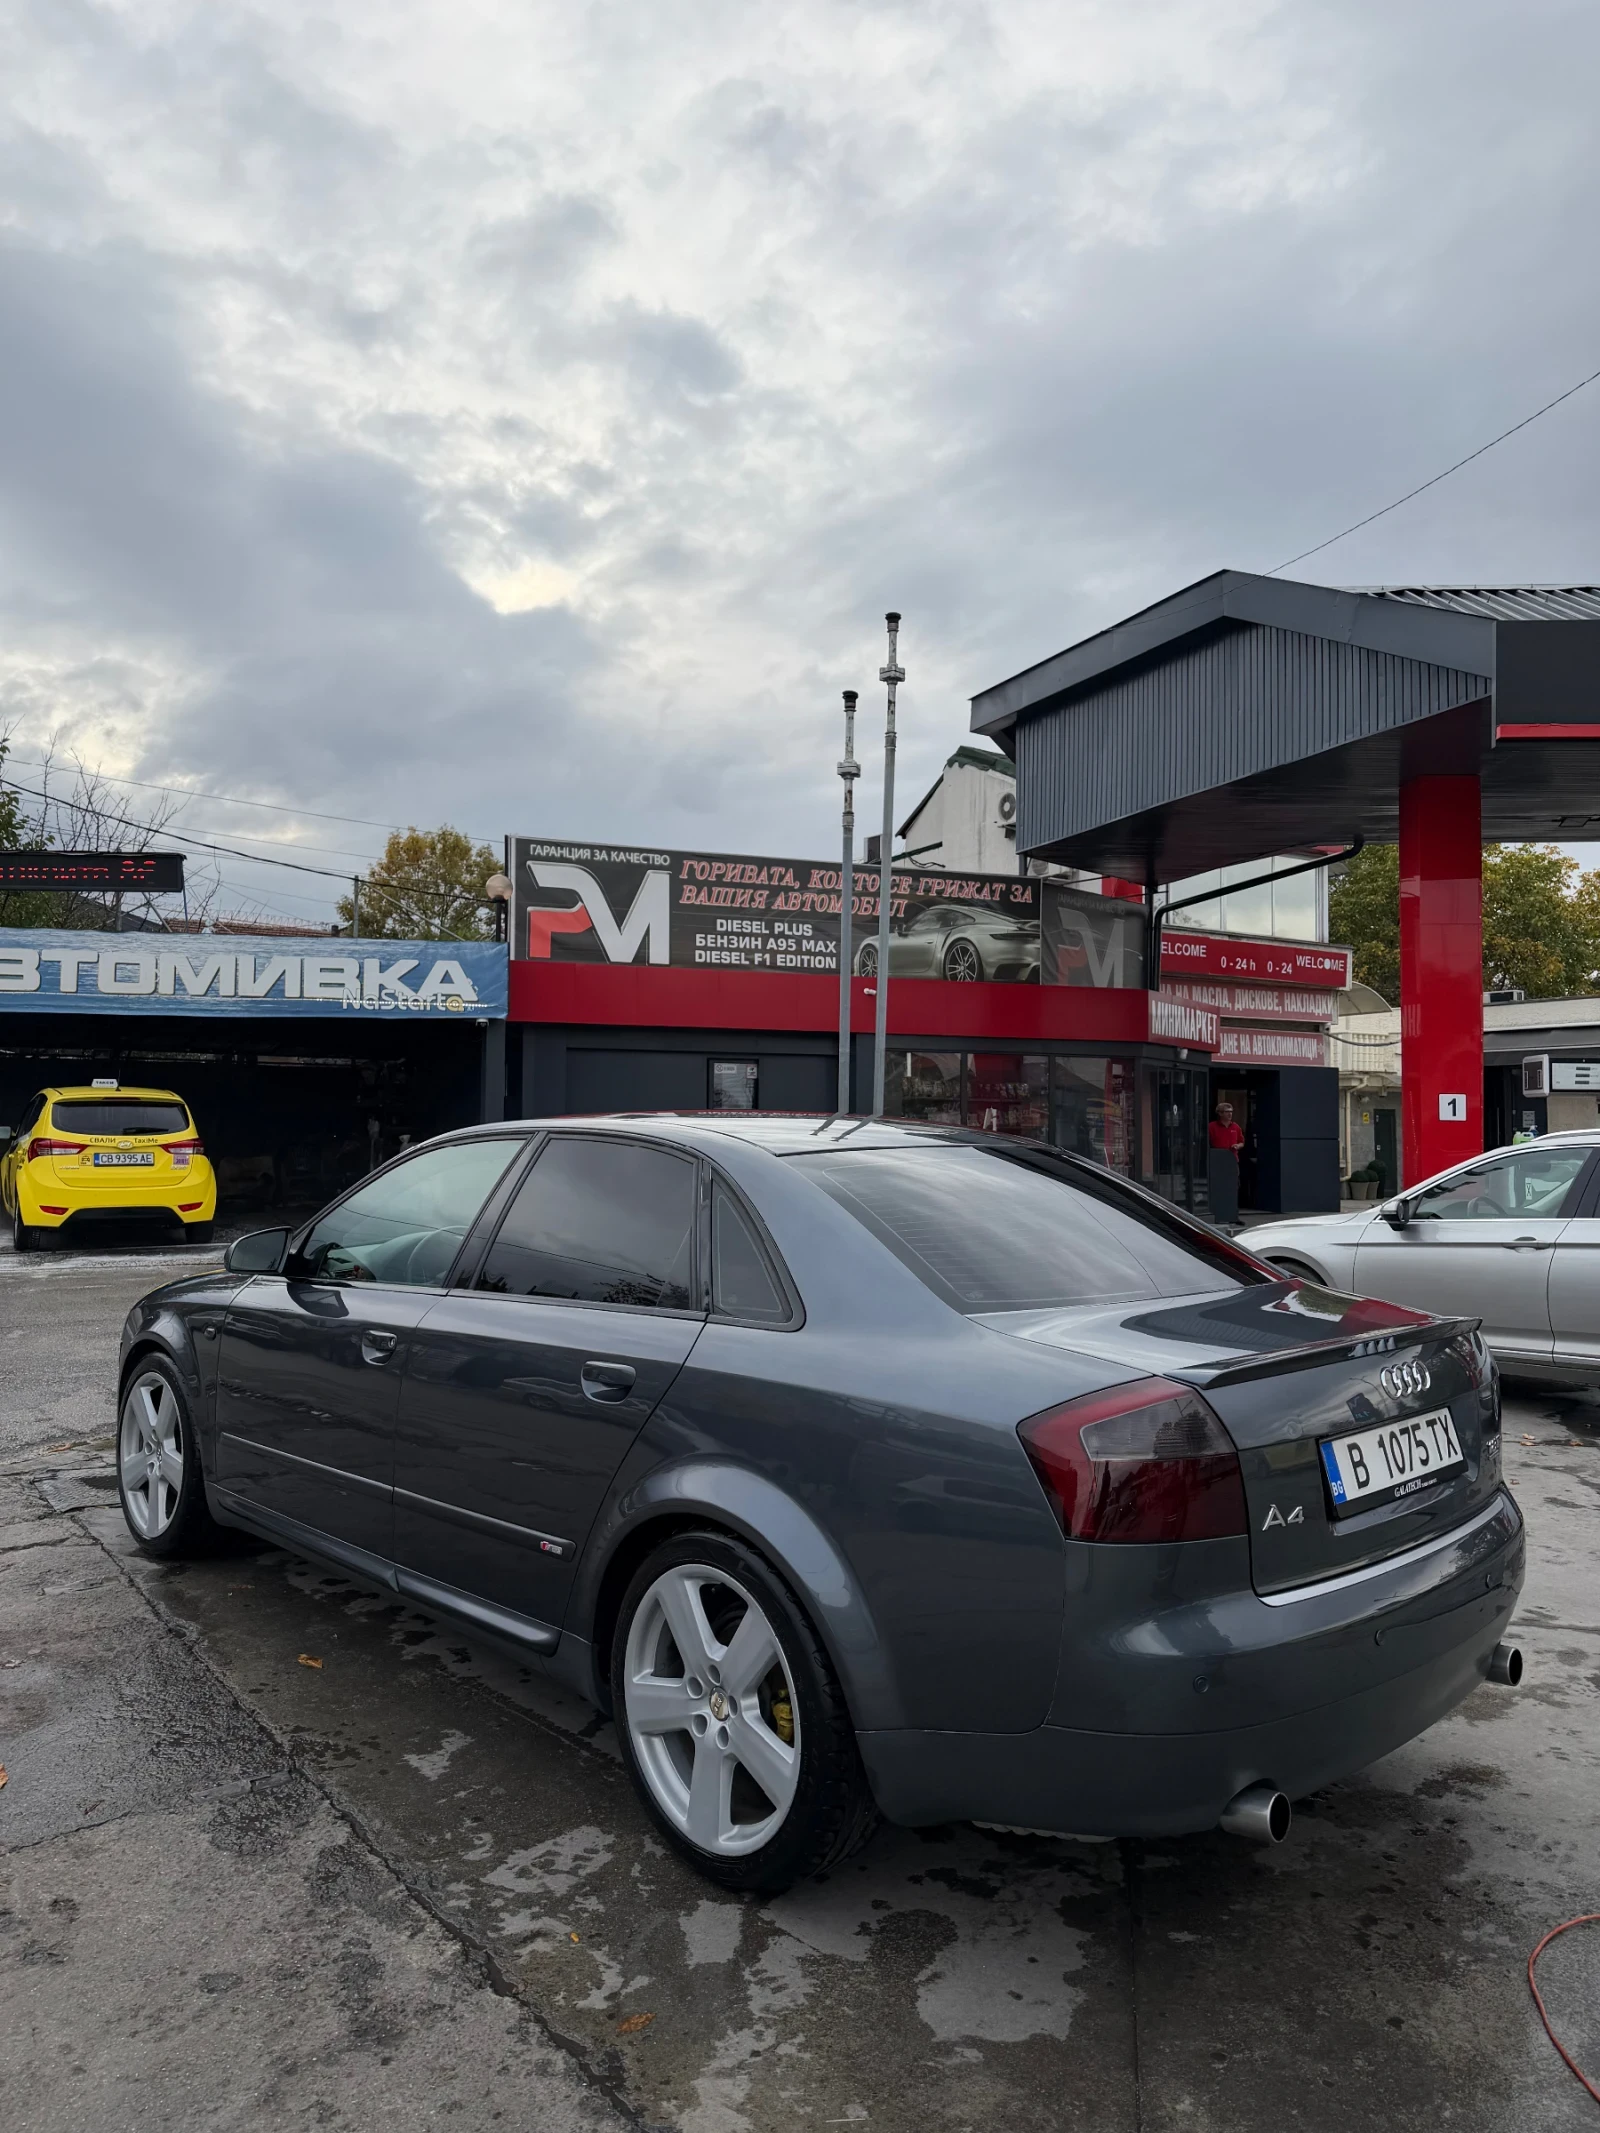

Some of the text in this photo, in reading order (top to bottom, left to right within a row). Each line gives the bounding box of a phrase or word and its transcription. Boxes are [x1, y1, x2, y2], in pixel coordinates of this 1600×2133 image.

[530, 844, 671, 866] ГАРАНЦИЯ ЗА КАЧЕСТВО
[679, 859, 800, 889] ГОРИВАТА,
[916, 877, 1006, 901] ГРИЖАТ
[1009, 884, 1033, 903] ЗА
[679, 885, 769, 909] ВАШИЯ
[716, 918, 813, 937] DIESEL PLUS
[695, 933, 837, 954] БЕНЗИН A95 MAX
[694, 950, 837, 969] DIESEL F1 EDITION
[1235, 958, 1248, 970] 24
[1281, 963, 1293, 975] 24
[1296, 955, 1345, 971] WELCOME
[1192, 985, 1232, 1011] МАСЛА,
[1234, 988, 1282, 1014] ДИСКОВЕ,
[1284, 993, 1333, 1017] НАКЛАДКИ
[1152, 1000, 1217, 1045] МИНИМАРКЕТ
[1240, 1033, 1251, 1055] НА
[1252, 1034, 1318, 1060] АВТОКЛИМАТИЦИ
[1447, 1098, 1457, 1117] 1
[115, 1154, 138, 1164] 9395
[1377, 1422, 1430, 1479] 1075
[1332, 1480, 1344, 1496] BG
[1261, 1503, 1305, 1531] A4
